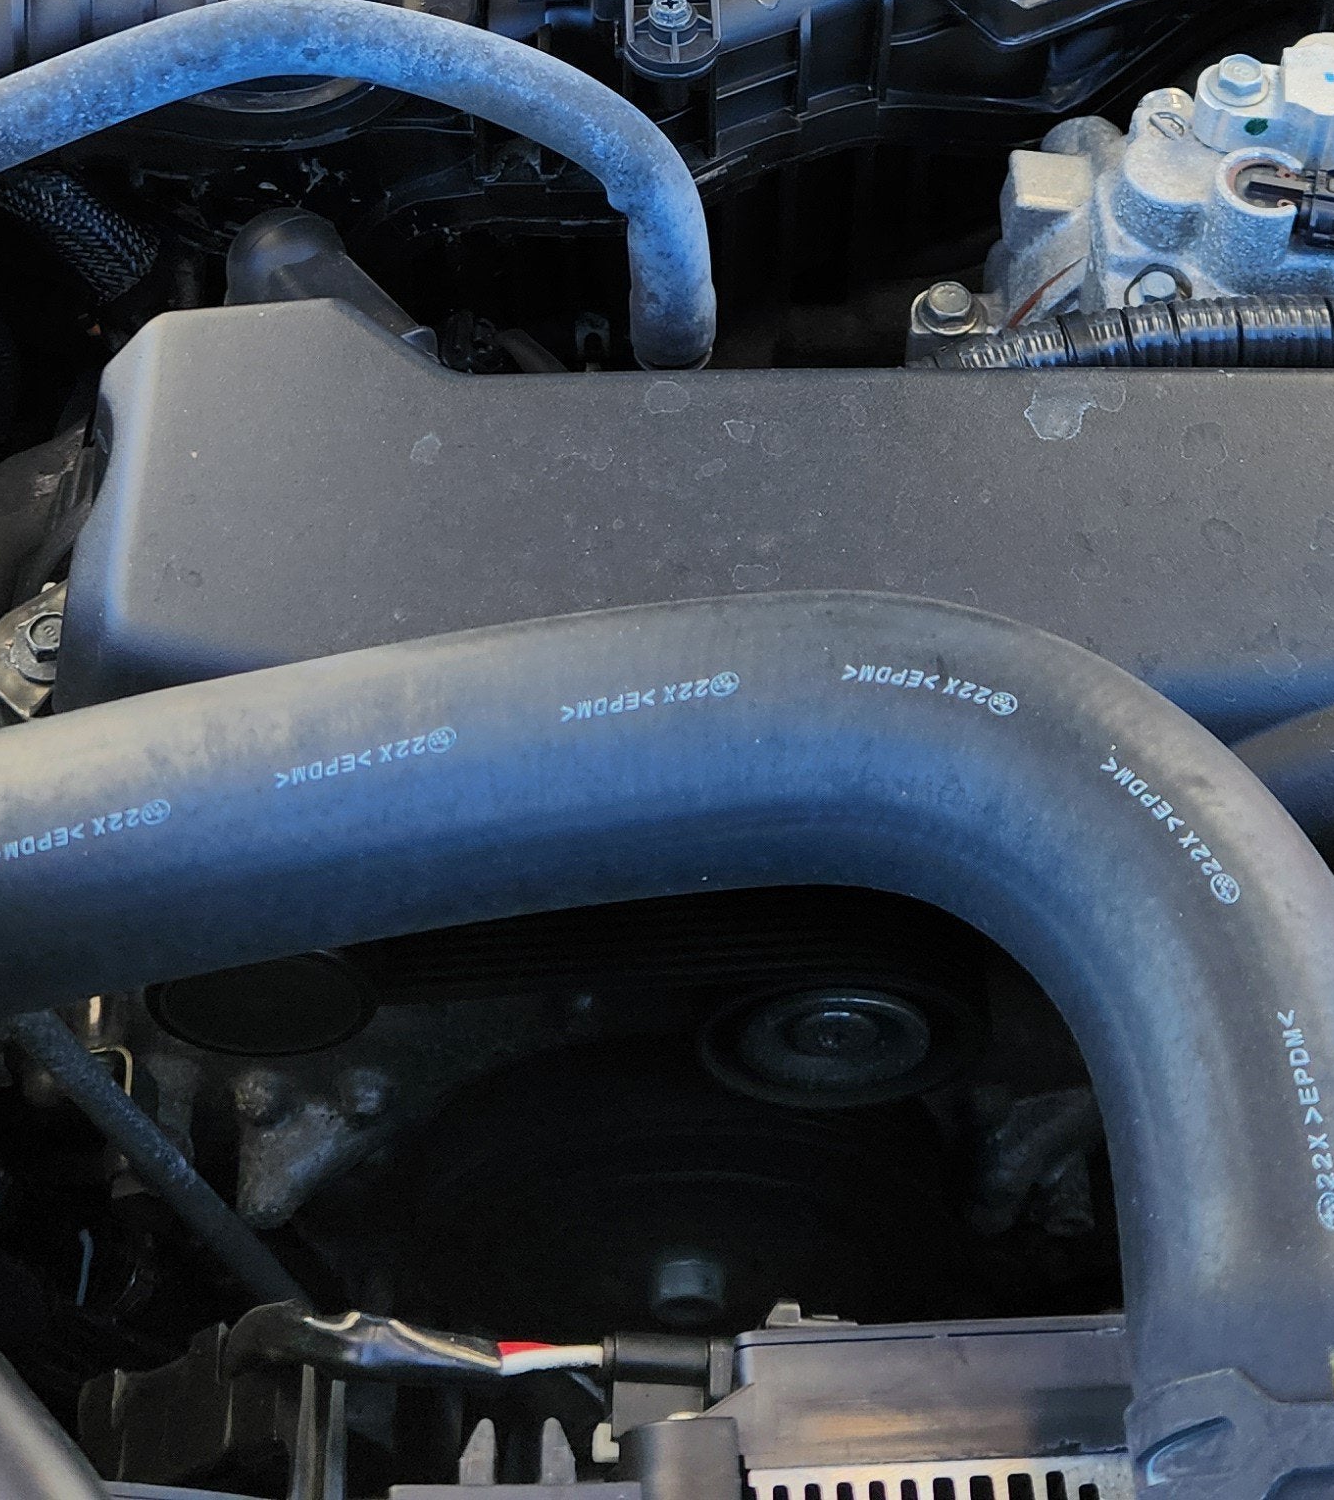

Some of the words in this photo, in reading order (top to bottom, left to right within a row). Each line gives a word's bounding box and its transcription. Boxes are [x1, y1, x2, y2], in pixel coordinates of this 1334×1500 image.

[663, 678, 710, 704] 22X
[941, 676, 993, 705] 22X
[378, 735, 426, 764] 22X
[91, 807, 140, 837] 22X
[1178, 830, 1223, 876] 22X
